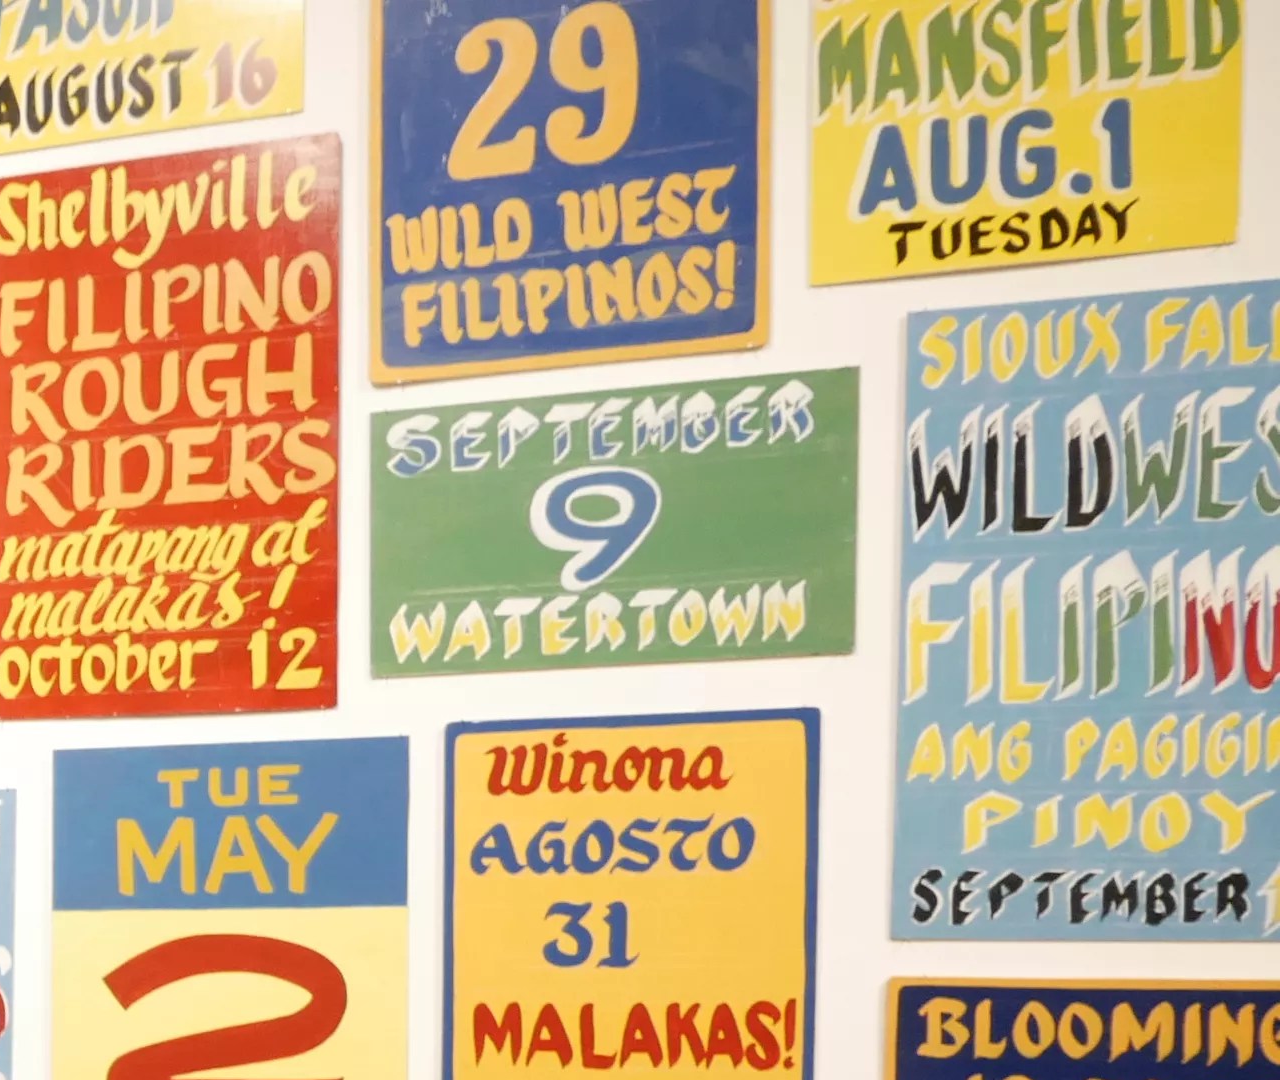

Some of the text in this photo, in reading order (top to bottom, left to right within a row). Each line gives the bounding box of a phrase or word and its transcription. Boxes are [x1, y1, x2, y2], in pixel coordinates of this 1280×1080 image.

[207, 37, 278, 110] 16
[446, 0, 639, 181] 29
[814, 0, 1241, 124] MANSFIELD
[386, 164, 737, 275] WILD WEST
[887, 197, 1140, 267] TUESDAY
[401, 240, 737, 347] FILIPINOS!
[918, 293, 1280, 389] SIOUX FAL
[9, 331, 318, 443] ROUGH
[386, 379, 815, 478] SEPTEMBER
[4, 418, 337, 528] RIDERS
[906, 392, 1117, 542] WILD
[251, 497, 328, 568] at
[529, 465, 662, 592] 9
[247, 625, 323, 690] 12
[389, 579, 807, 664] WATERTOWN
[902, 545, 1280, 705] FILIPINO
[157, 763, 301, 809] TUE
[485, 732, 732, 797] Winona
[905, 720, 1033, 784] ANG
[115, 812, 339, 898] MAY
[469, 816, 757, 876] AGOSTO
[961, 789, 1276, 855] PINOY
[543, 901, 641, 969] 31
[910, 866, 1251, 926] SEPTEMBER
[472, 998, 798, 1072] MALAKAS!
